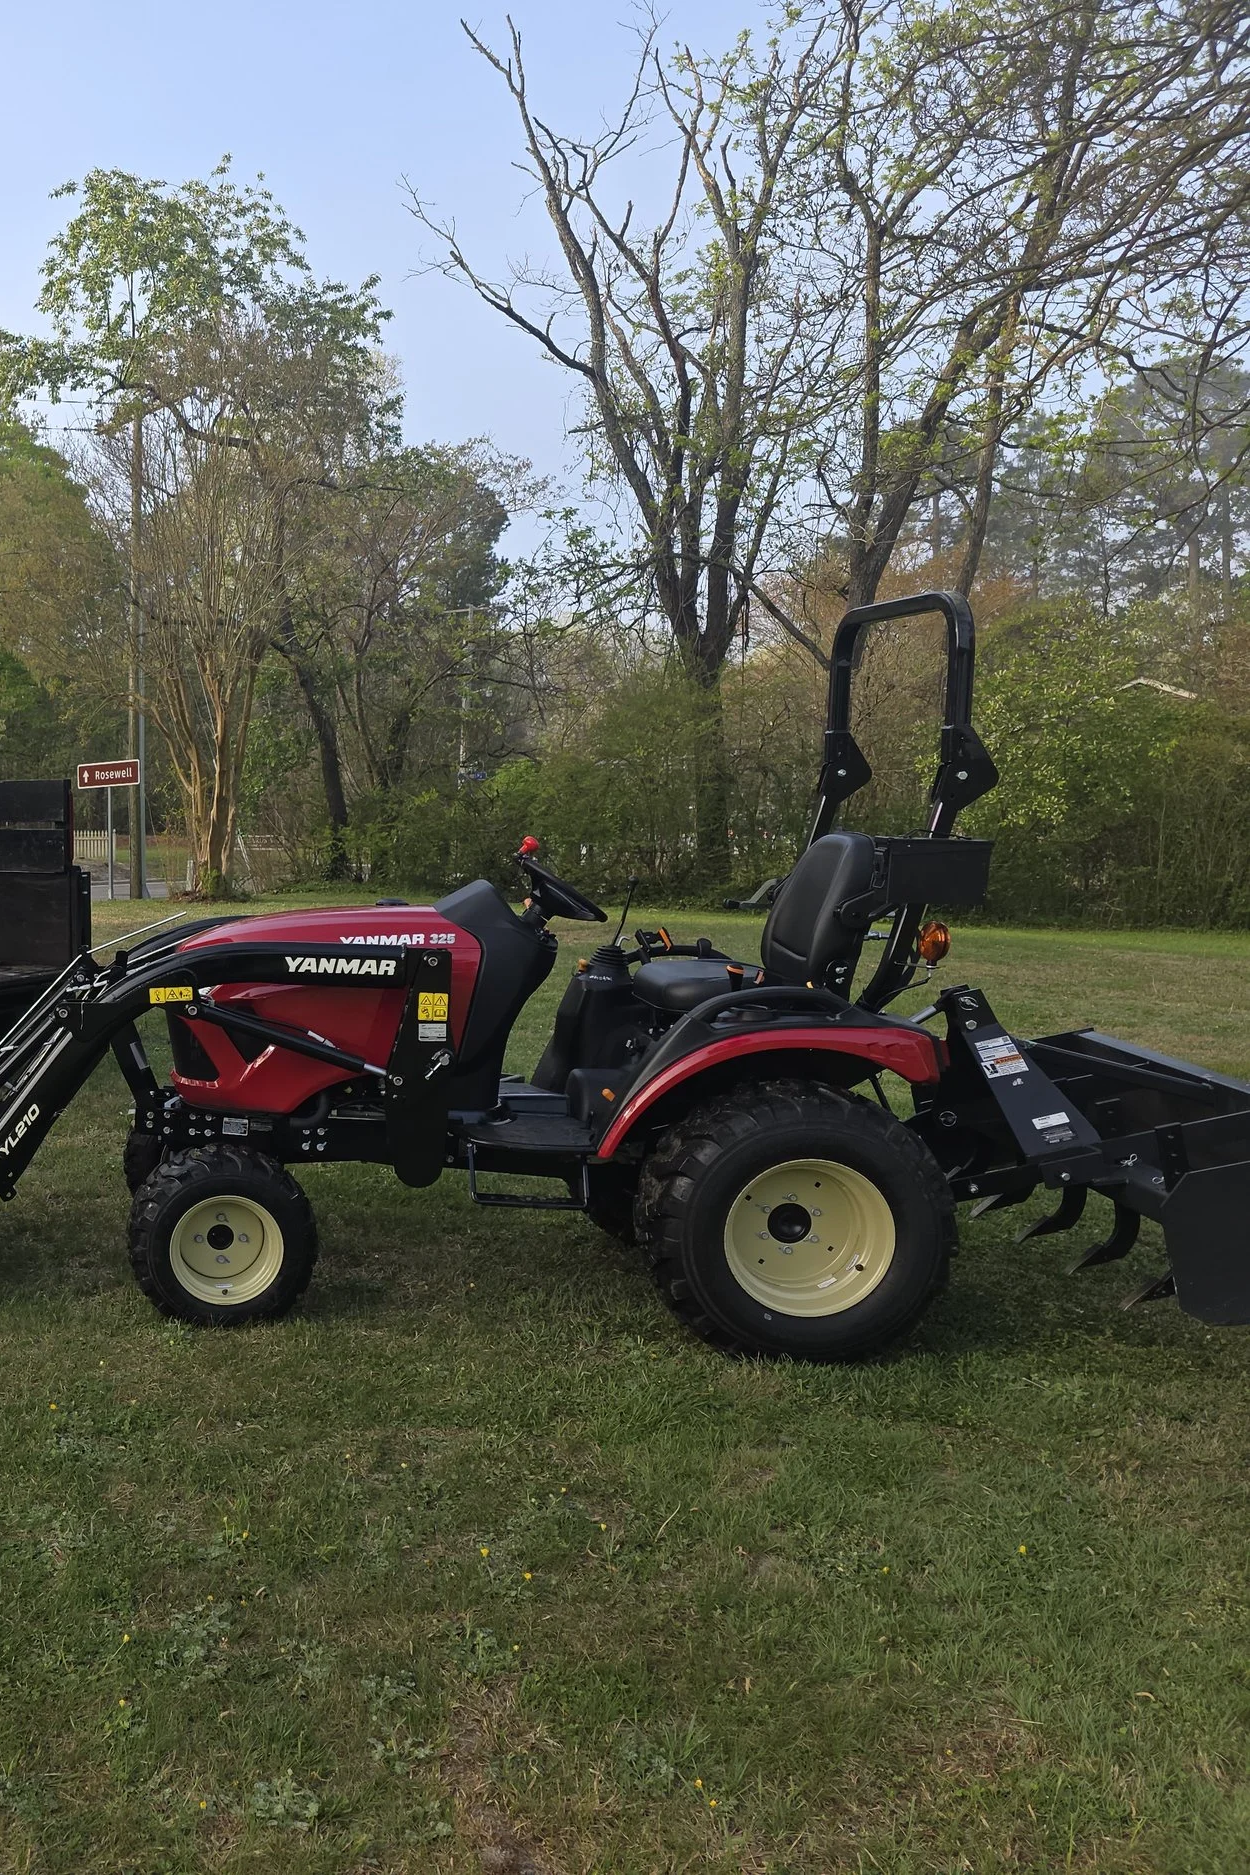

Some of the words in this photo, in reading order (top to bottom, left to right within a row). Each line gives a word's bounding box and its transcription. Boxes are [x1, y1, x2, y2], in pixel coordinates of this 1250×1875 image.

[95, 767, 132, 780] Rosewell
[339, 934, 425, 946] YANMAR
[429, 934, 456, 944] 325
[284, 956, 397, 976] YANMAR
